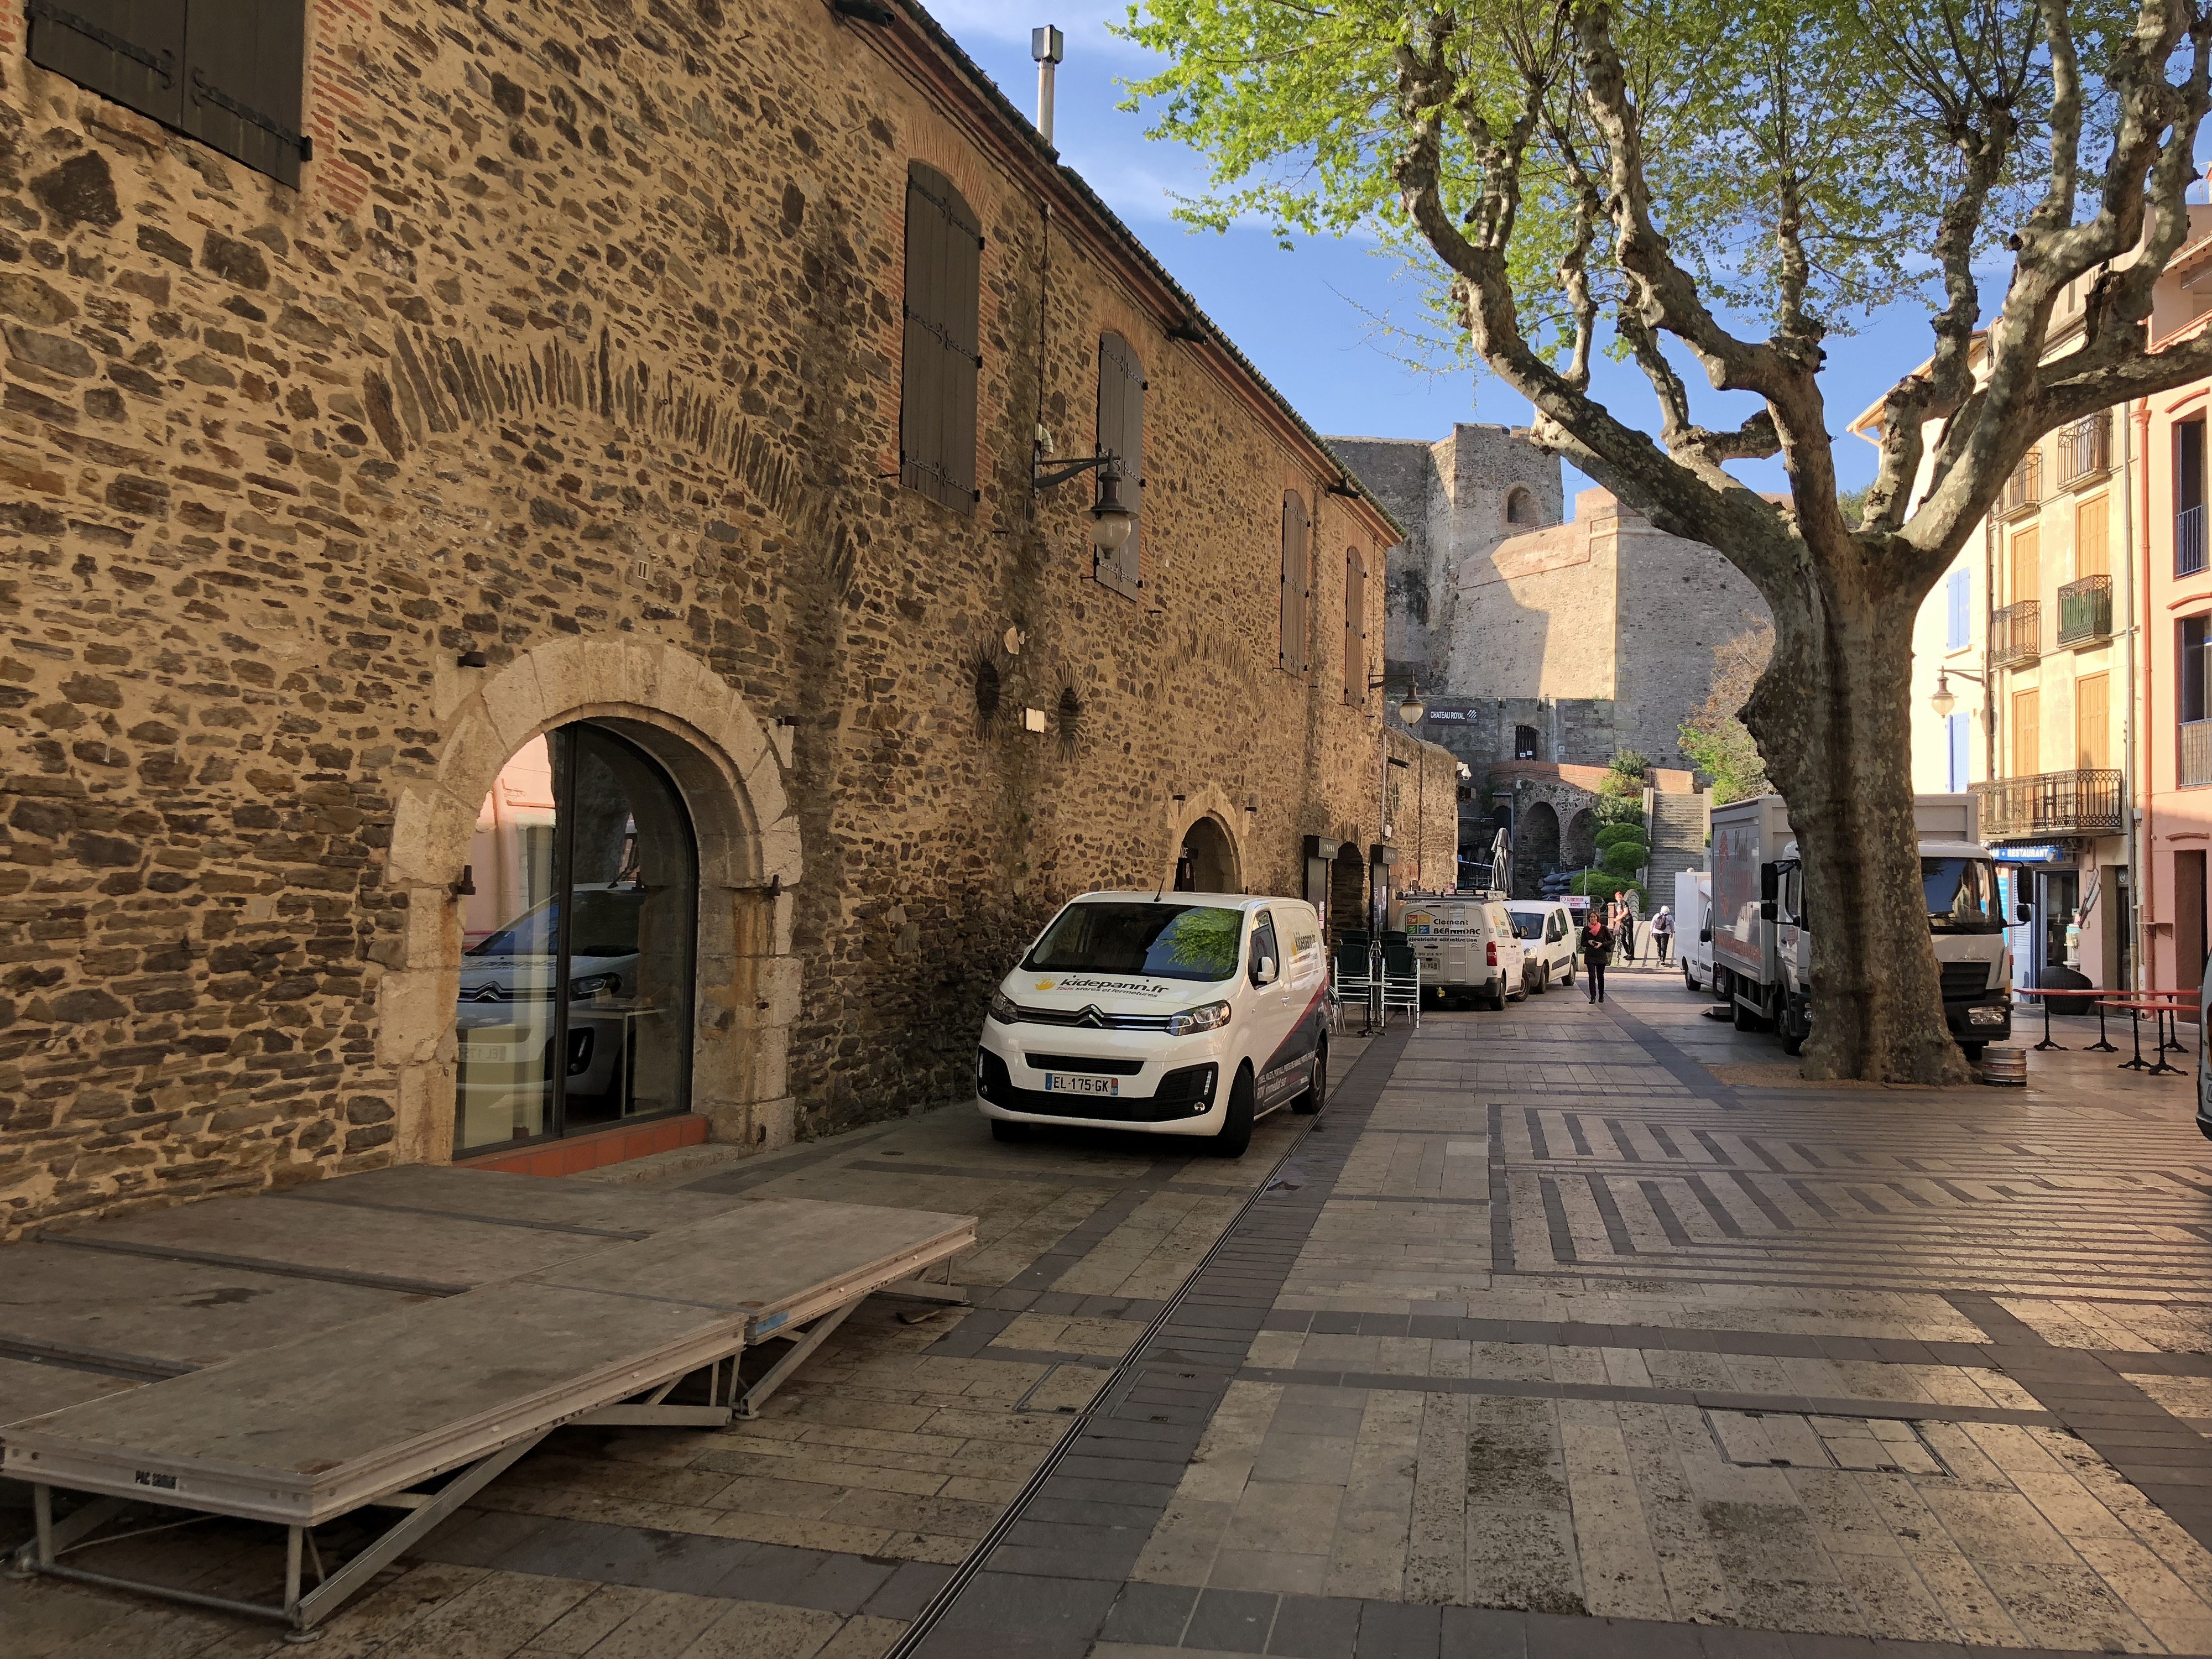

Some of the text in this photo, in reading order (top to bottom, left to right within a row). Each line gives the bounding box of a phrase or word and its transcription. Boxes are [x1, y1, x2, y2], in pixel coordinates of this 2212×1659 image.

[2007, 849, 2049, 857] RESTAURANT
[1060, 979, 1170, 994] kidepann.fr
[1111, 988, 1159, 998] fermetures
[1053, 1076, 1109, 1092] EL-175-GK
